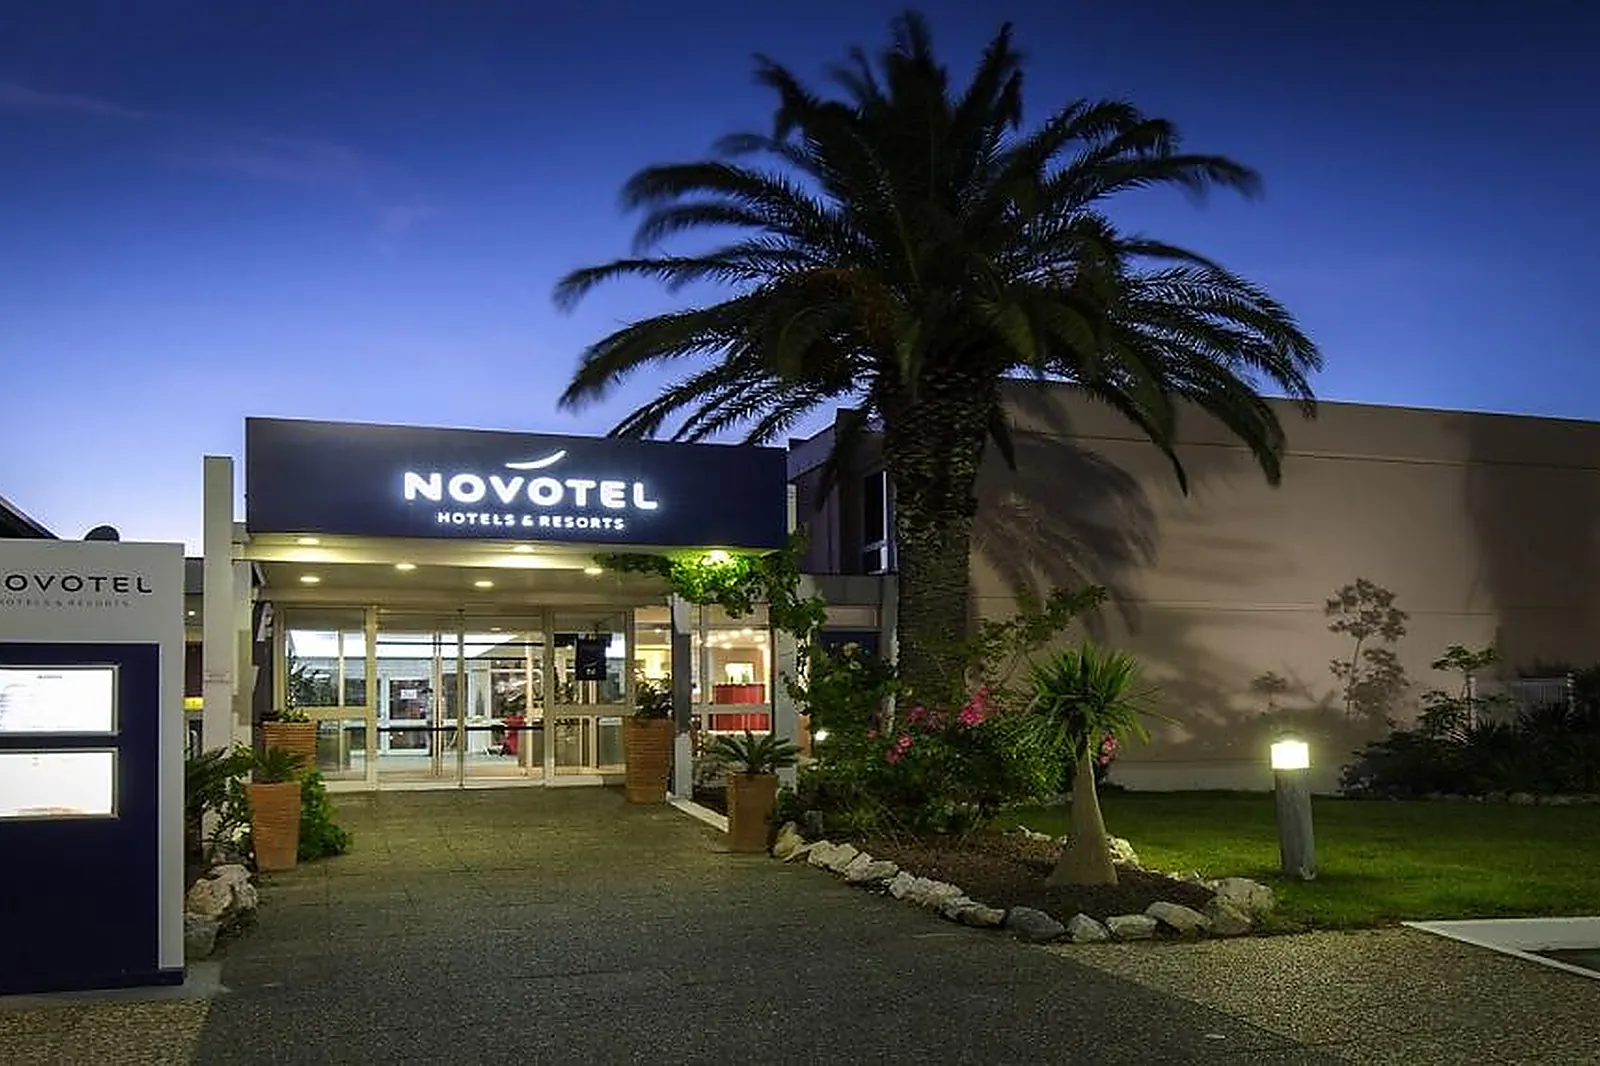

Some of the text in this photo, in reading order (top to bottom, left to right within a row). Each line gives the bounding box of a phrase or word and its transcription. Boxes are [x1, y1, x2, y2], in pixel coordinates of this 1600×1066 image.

[404, 471, 659, 510] NOVOTEL
[437, 512, 625, 530] HOTELS & RESORTS
[5, 574, 153, 593] OVOTEL
